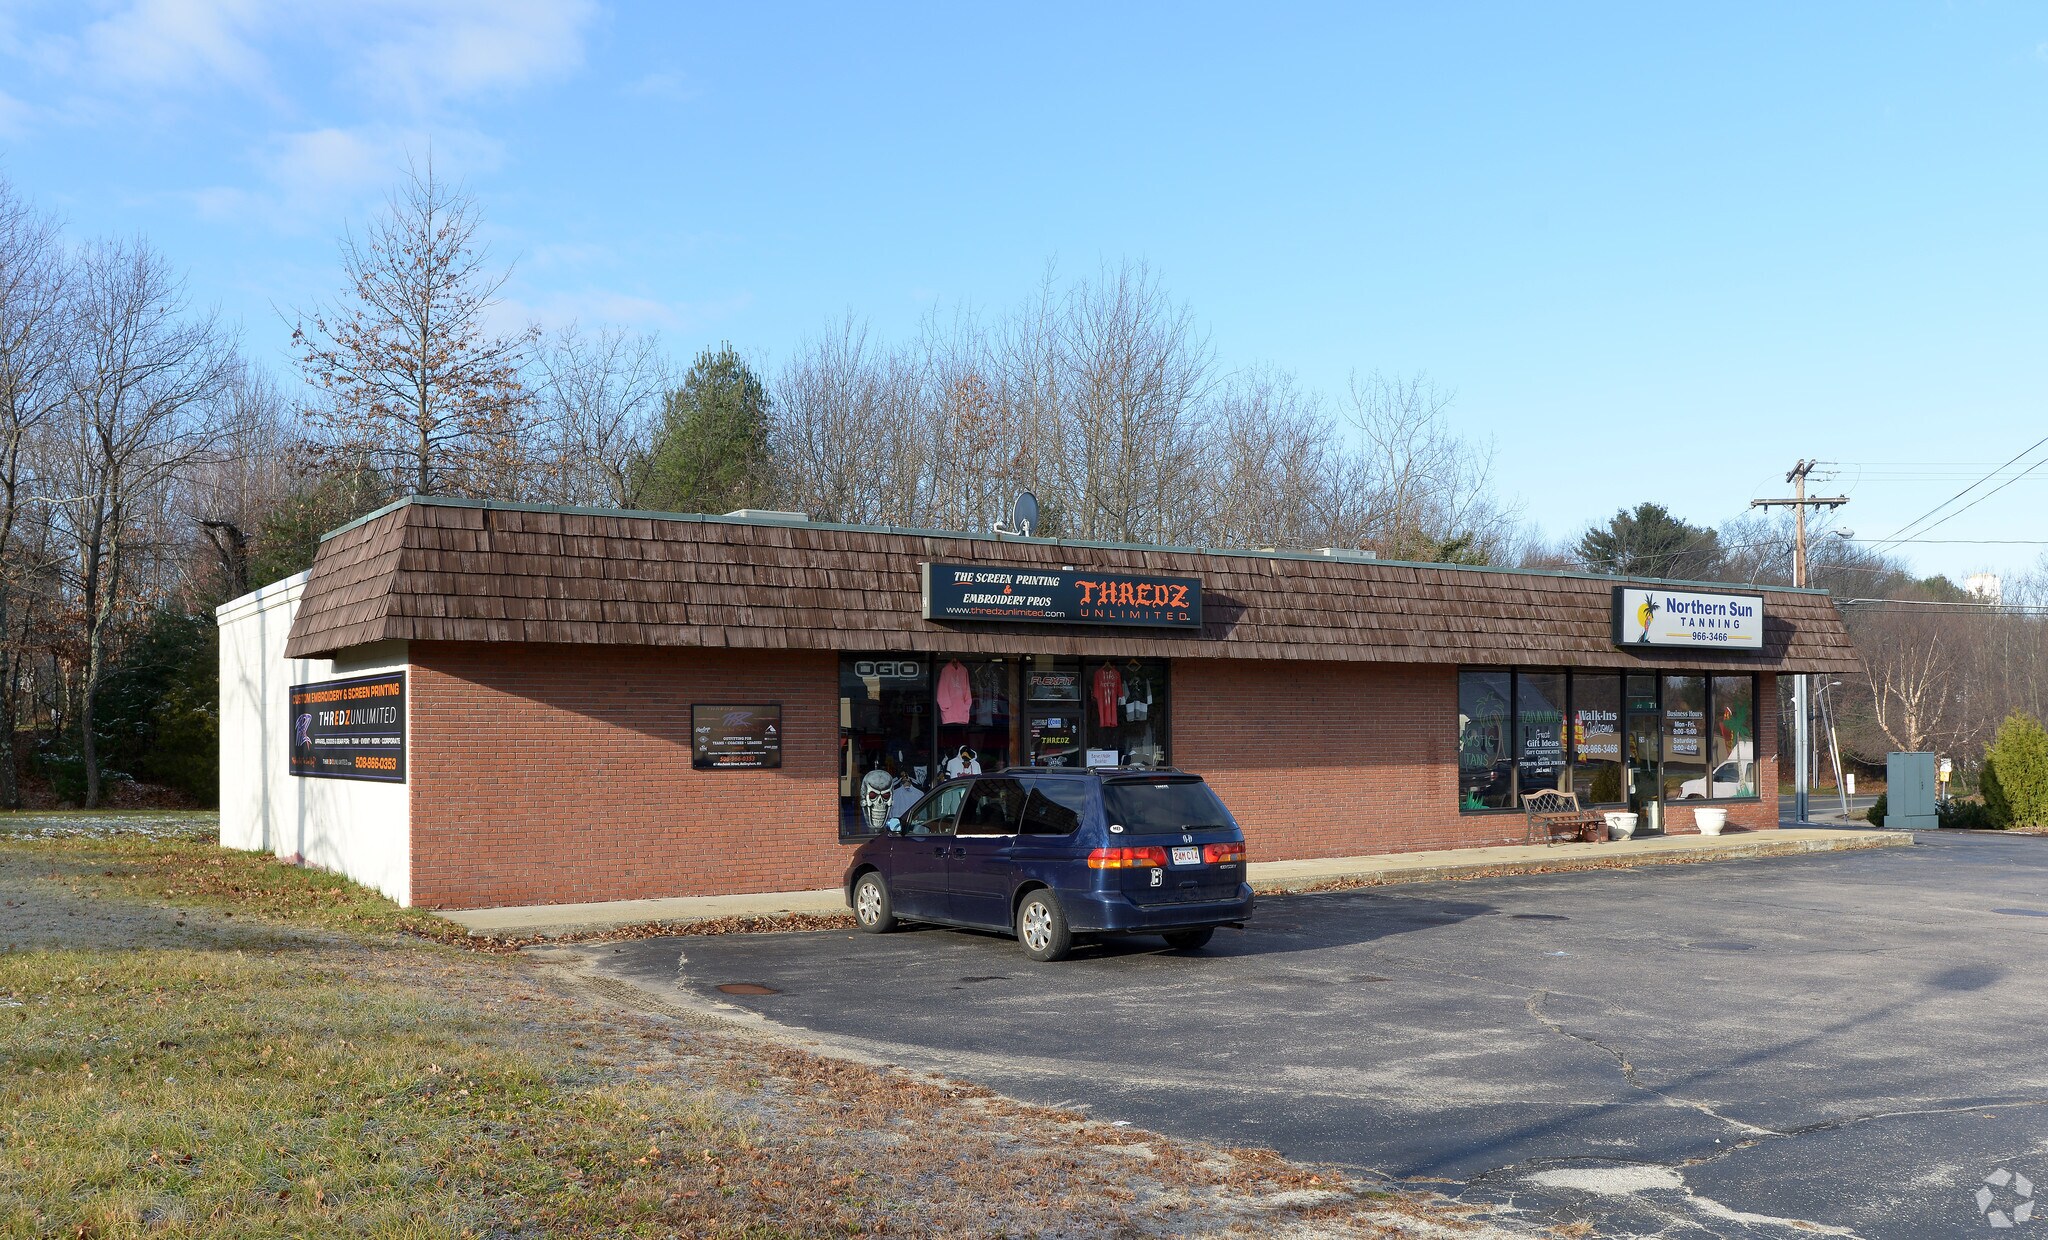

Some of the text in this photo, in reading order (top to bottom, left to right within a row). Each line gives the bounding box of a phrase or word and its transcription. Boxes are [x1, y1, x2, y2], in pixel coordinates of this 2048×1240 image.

[954, 571, 1061, 587] THE SCREEN PRINTING
[1003, 584, 1013, 594] &
[1074, 580, 1190, 608] THREDZ
[963, 593, 1052, 607] EMBROIDERY PROS
[946, 607, 1066, 618] www.thredzunlimited.com
[1666, 597, 1753, 617] Northern Sun
[1080, 609, 1188, 621] UNLIMITED
[1680, 617, 1740, 629] TANNING
[1692, 631, 1728, 642] 966-3466
[855, 661, 919, 678] OGIO
[311, 689, 343, 704] EMBROIDERY
[348, 686, 371, 700] SCREEN
[370, 683, 400, 698] PRINTING
[1582, 720, 1615, 739] Welcome
[1526, 739, 1560, 747] Gift Ideas
[1577, 744, 1618, 754] 508-966-3466
